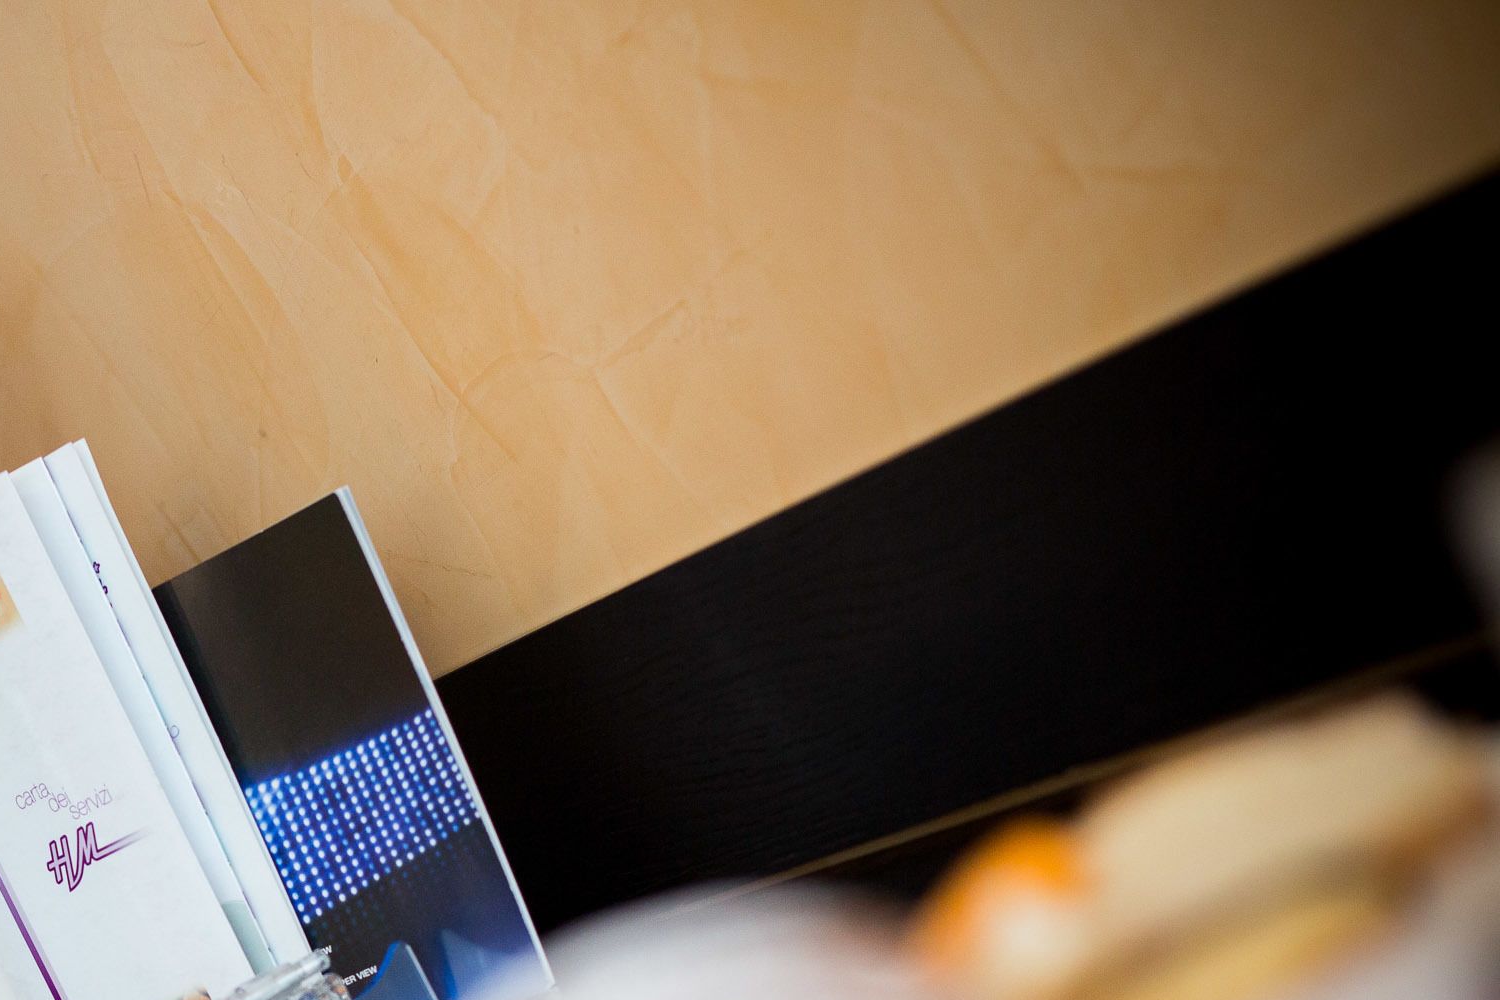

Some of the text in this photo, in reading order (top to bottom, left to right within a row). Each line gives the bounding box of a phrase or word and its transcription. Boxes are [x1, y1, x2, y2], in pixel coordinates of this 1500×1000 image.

[15, 783, 50, 810] carta
[48, 787, 71, 813] dei
[68, 784, 113, 820] servizi
[356, 965, 378, 980] VIEW
